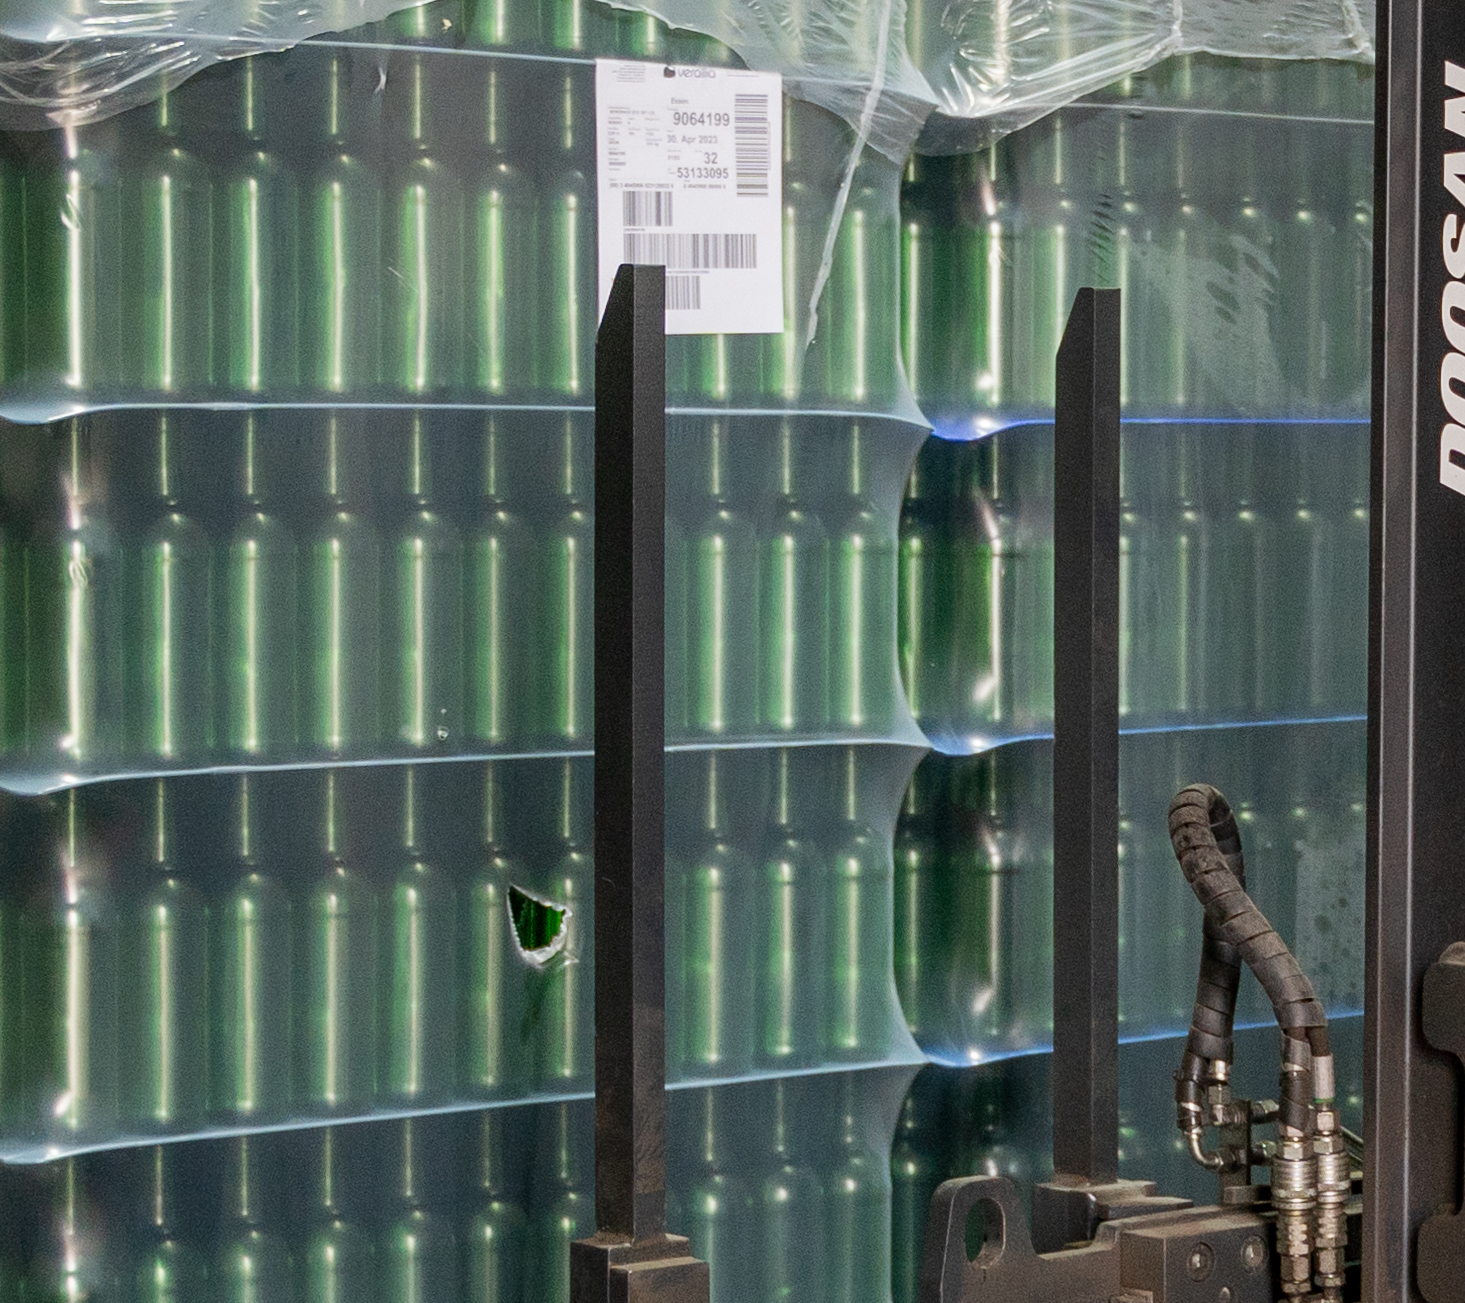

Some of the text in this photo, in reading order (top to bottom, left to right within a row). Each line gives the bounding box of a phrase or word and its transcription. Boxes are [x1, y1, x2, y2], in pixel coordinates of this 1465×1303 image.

[677, 67, 716, 79] verallia
[673, 111, 730, 127] 9064199
[667, 134, 718, 145] 30. Apr 2023
[703, 151, 718, 165] 32
[677, 167, 729, 179] 53133095
